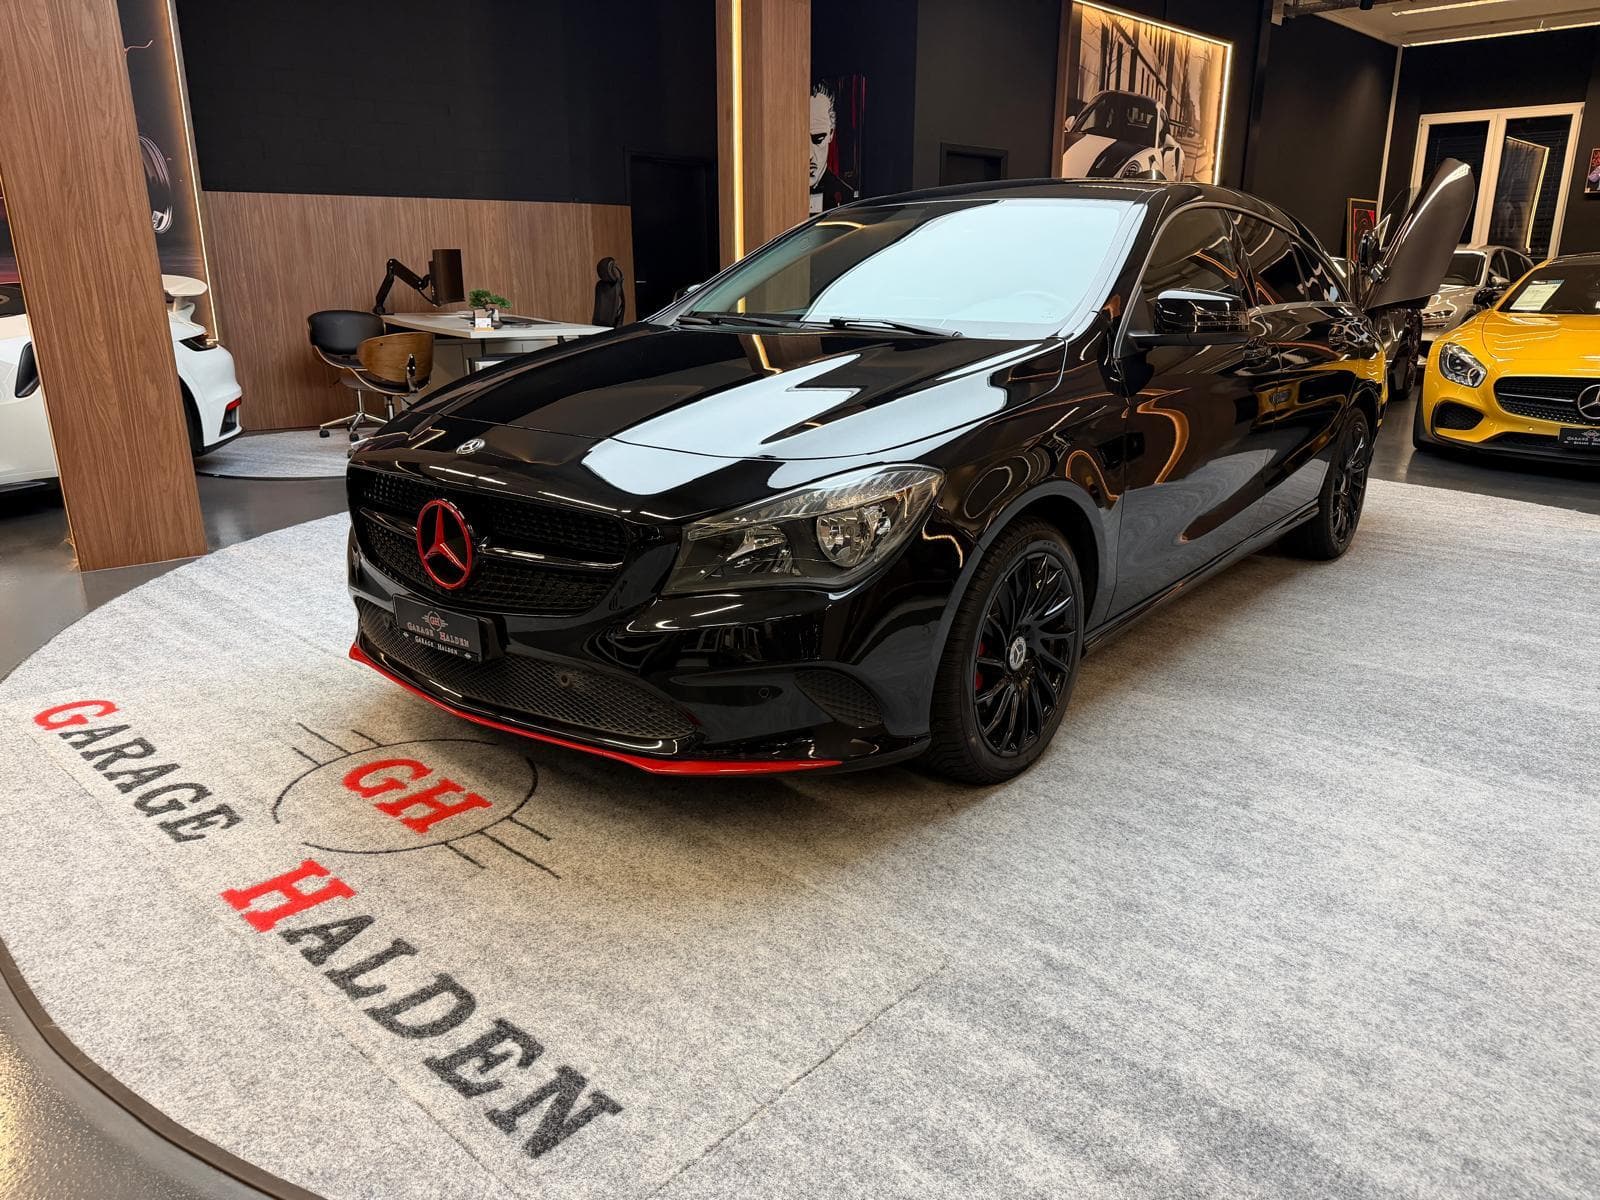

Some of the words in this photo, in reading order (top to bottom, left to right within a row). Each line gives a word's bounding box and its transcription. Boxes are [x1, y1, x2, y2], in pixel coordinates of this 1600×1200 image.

[407, 622, 434, 637] GARAGE
[440, 632, 470, 648] HALDEN
[414, 635, 434, 648] GARAGE
[438, 644, 458, 655] HALDEN
[342, 757, 493, 834] GH
[33, 699, 242, 843] GARAGE
[220, 858, 623, 1159] HALDEN
